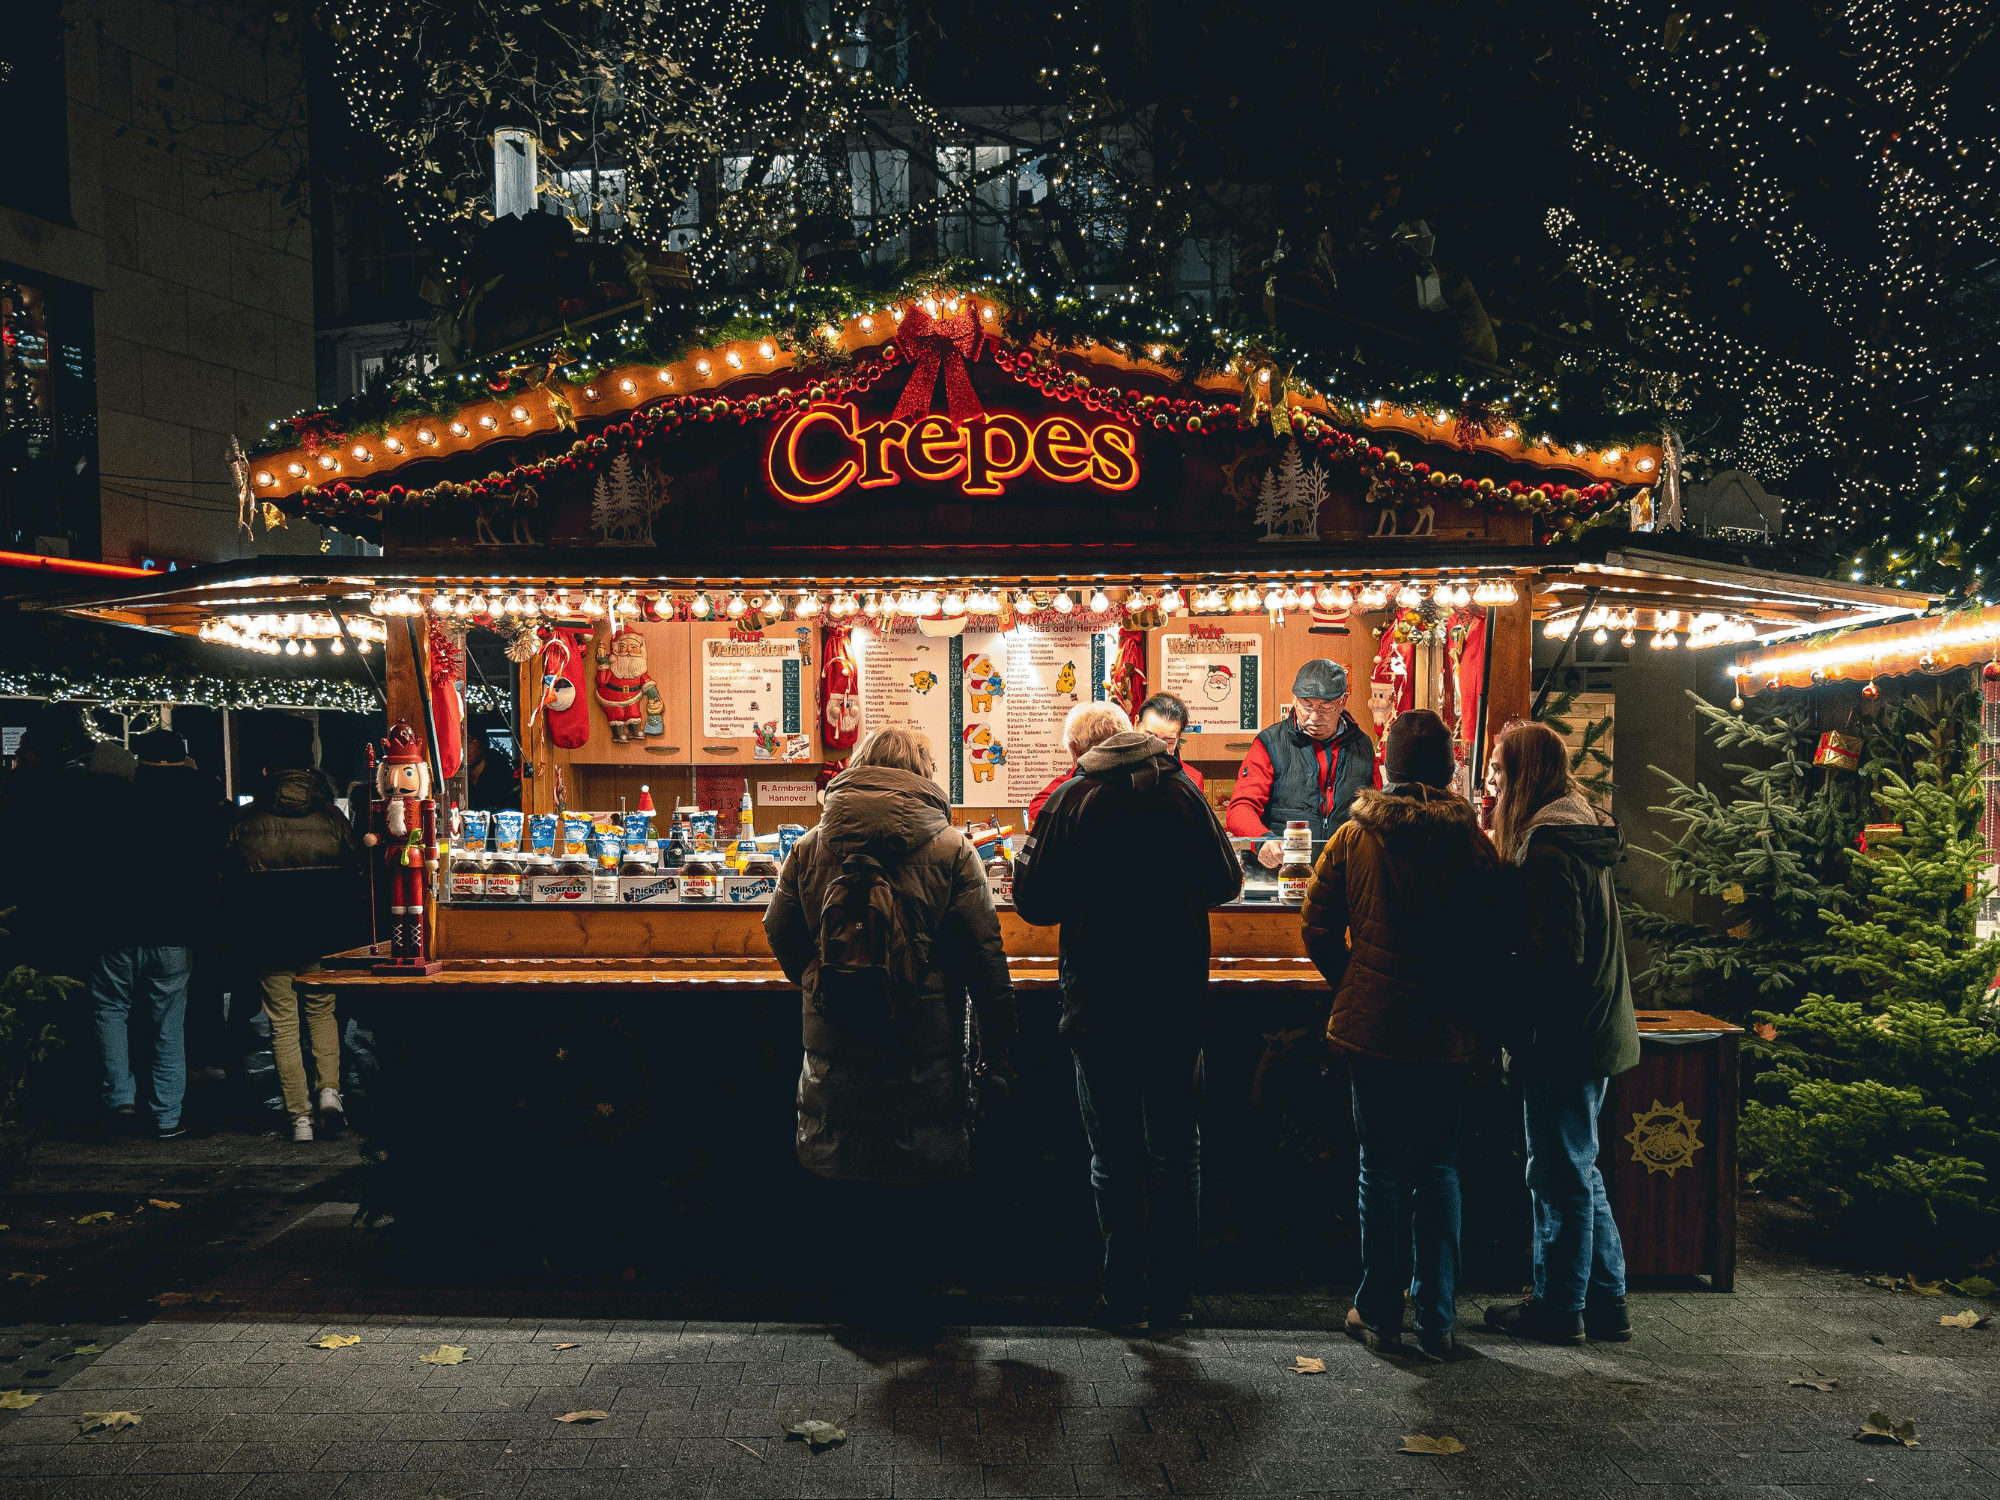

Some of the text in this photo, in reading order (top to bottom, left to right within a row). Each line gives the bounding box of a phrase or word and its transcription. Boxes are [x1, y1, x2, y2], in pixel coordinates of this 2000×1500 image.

[768, 402, 1140, 504] Crepes
[888, 627, 918, 636] repes
[1053, 625, 1075, 633] oder
[772, 784, 814, 792] Armbrecht
[453, 877, 479, 885] nutella
[487, 878, 514, 886] nutella
[538, 885, 587, 895] Yogurette
[630, 886, 669, 894] Snickers
[731, 886, 777, 895] Milky Wa
